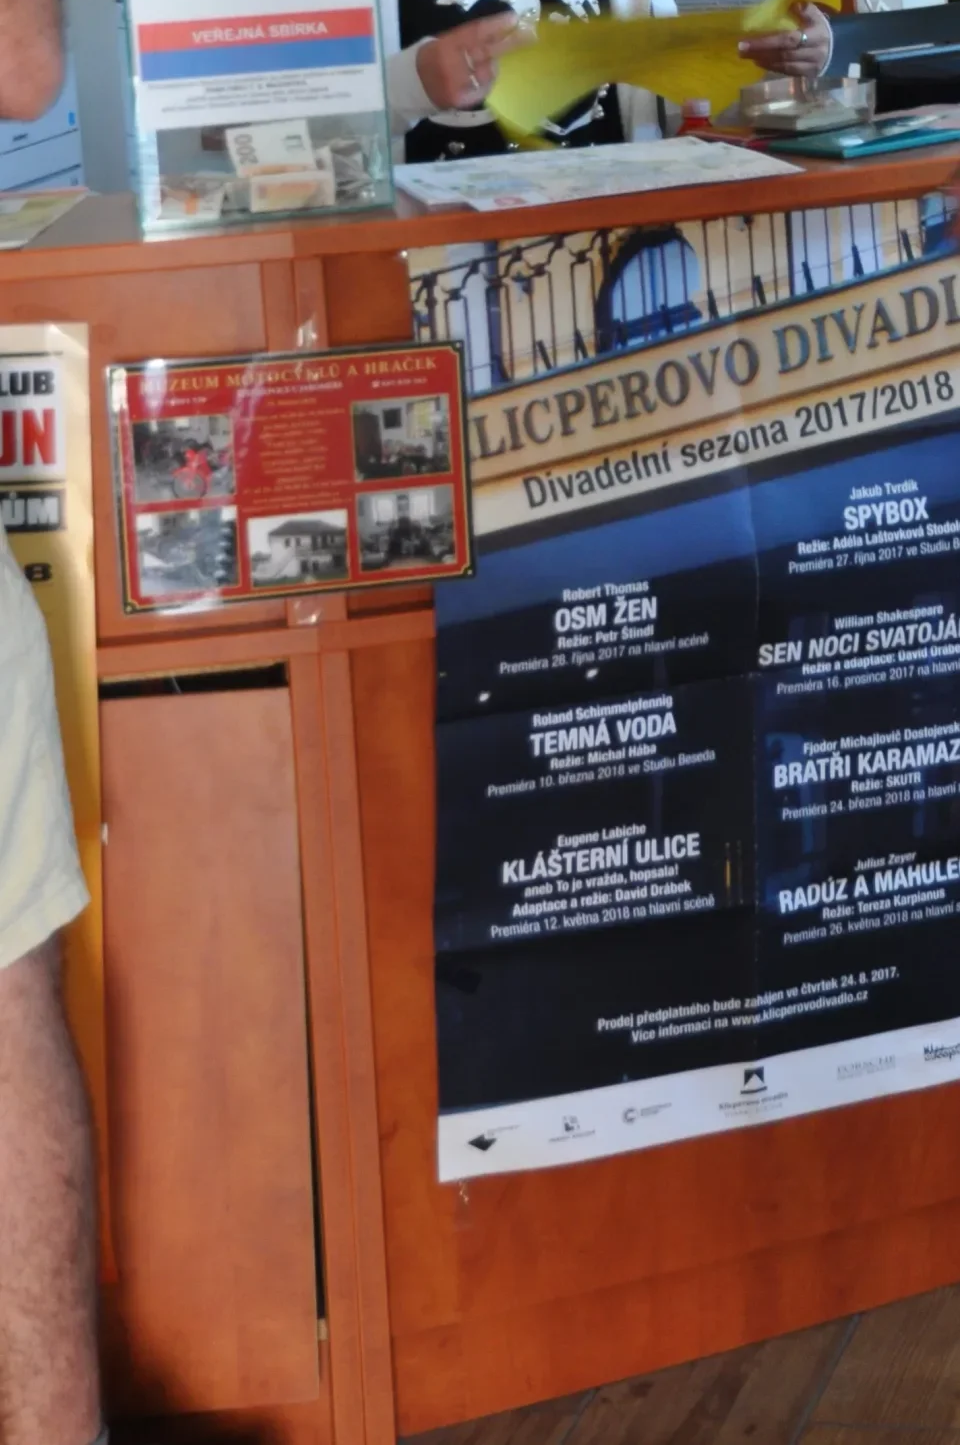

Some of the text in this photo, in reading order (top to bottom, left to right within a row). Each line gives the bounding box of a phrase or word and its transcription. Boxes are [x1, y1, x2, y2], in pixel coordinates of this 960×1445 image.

[192, 21, 328, 44] VEŘEJNÁ SBÍRKA
[347, 362, 360, 377] A
[363, 355, 437, 376] HRAČEK
[470, 338, 760, 462] LICPEROVO
[523, 370, 954, 508] Divadelní sezona 2017/2018
[848, 479, 919, 500] Jakub Tvrdík
[842, 496, 929, 531] SPYBOX
[797, 540, 831, 555] Režie:
[831, 534, 863, 550] Adéla
[864, 525, 925, 546] Laštovková
[787, 557, 834, 574] Premiéra
[835, 553, 852, 567] 27.
[853, 551, 876, 566] října
[877, 545, 903, 561] 2017
[905, 546, 918, 556] ve
[919, 540, 951, 555] Studiu
[561, 581, 649, 602] Robert Thomas
[553, 596, 657, 633] OSM ŽEN
[833, 604, 944, 630] William Shakespeare
[556, 624, 654, 650] Režie: Petr Štindl
[757, 640, 803, 666] SEN
[807, 632, 860, 659] NOCI
[801, 662, 832, 675] Režie
[842, 653, 896, 670] adaptace:
[897, 647, 929, 662] David
[531, 709, 573, 728] Roland
[528, 711, 677, 757] TEMNÁ VODA
[801, 740, 839, 757] Fjodor
[837, 730, 901, 754] Michajlovič
[549, 743, 657, 770] Režie: Michal Hába
[773, 753, 851, 789] BRATŘI
[850, 771, 921, 793] Režie: SKUTR
[552, 824, 646, 851] Eugene Labiche
[501, 833, 700, 884] KLÁŠTERNÍ ULICE
[853, 852, 919, 871] Julius Zeyer
[523, 864, 679, 898] aneb To je vražda, hopsala!
[777, 878, 848, 914] RADÚZ
[511, 899, 567, 917] Adaptace
[579, 892, 612, 907] režie:
[614, 885, 648, 902] David
[649, 880, 691, 897] Drábek
[821, 888, 945, 920] Režie: Tereza Karpianus
[596, 966, 899, 1032] Prodej předplatného bude zahájen ve čtvrtek 24. 8. 2017.
[630, 1029, 656, 1043] Více
[657, 1018, 711, 1038] informací
[713, 1017, 729, 1029] na
